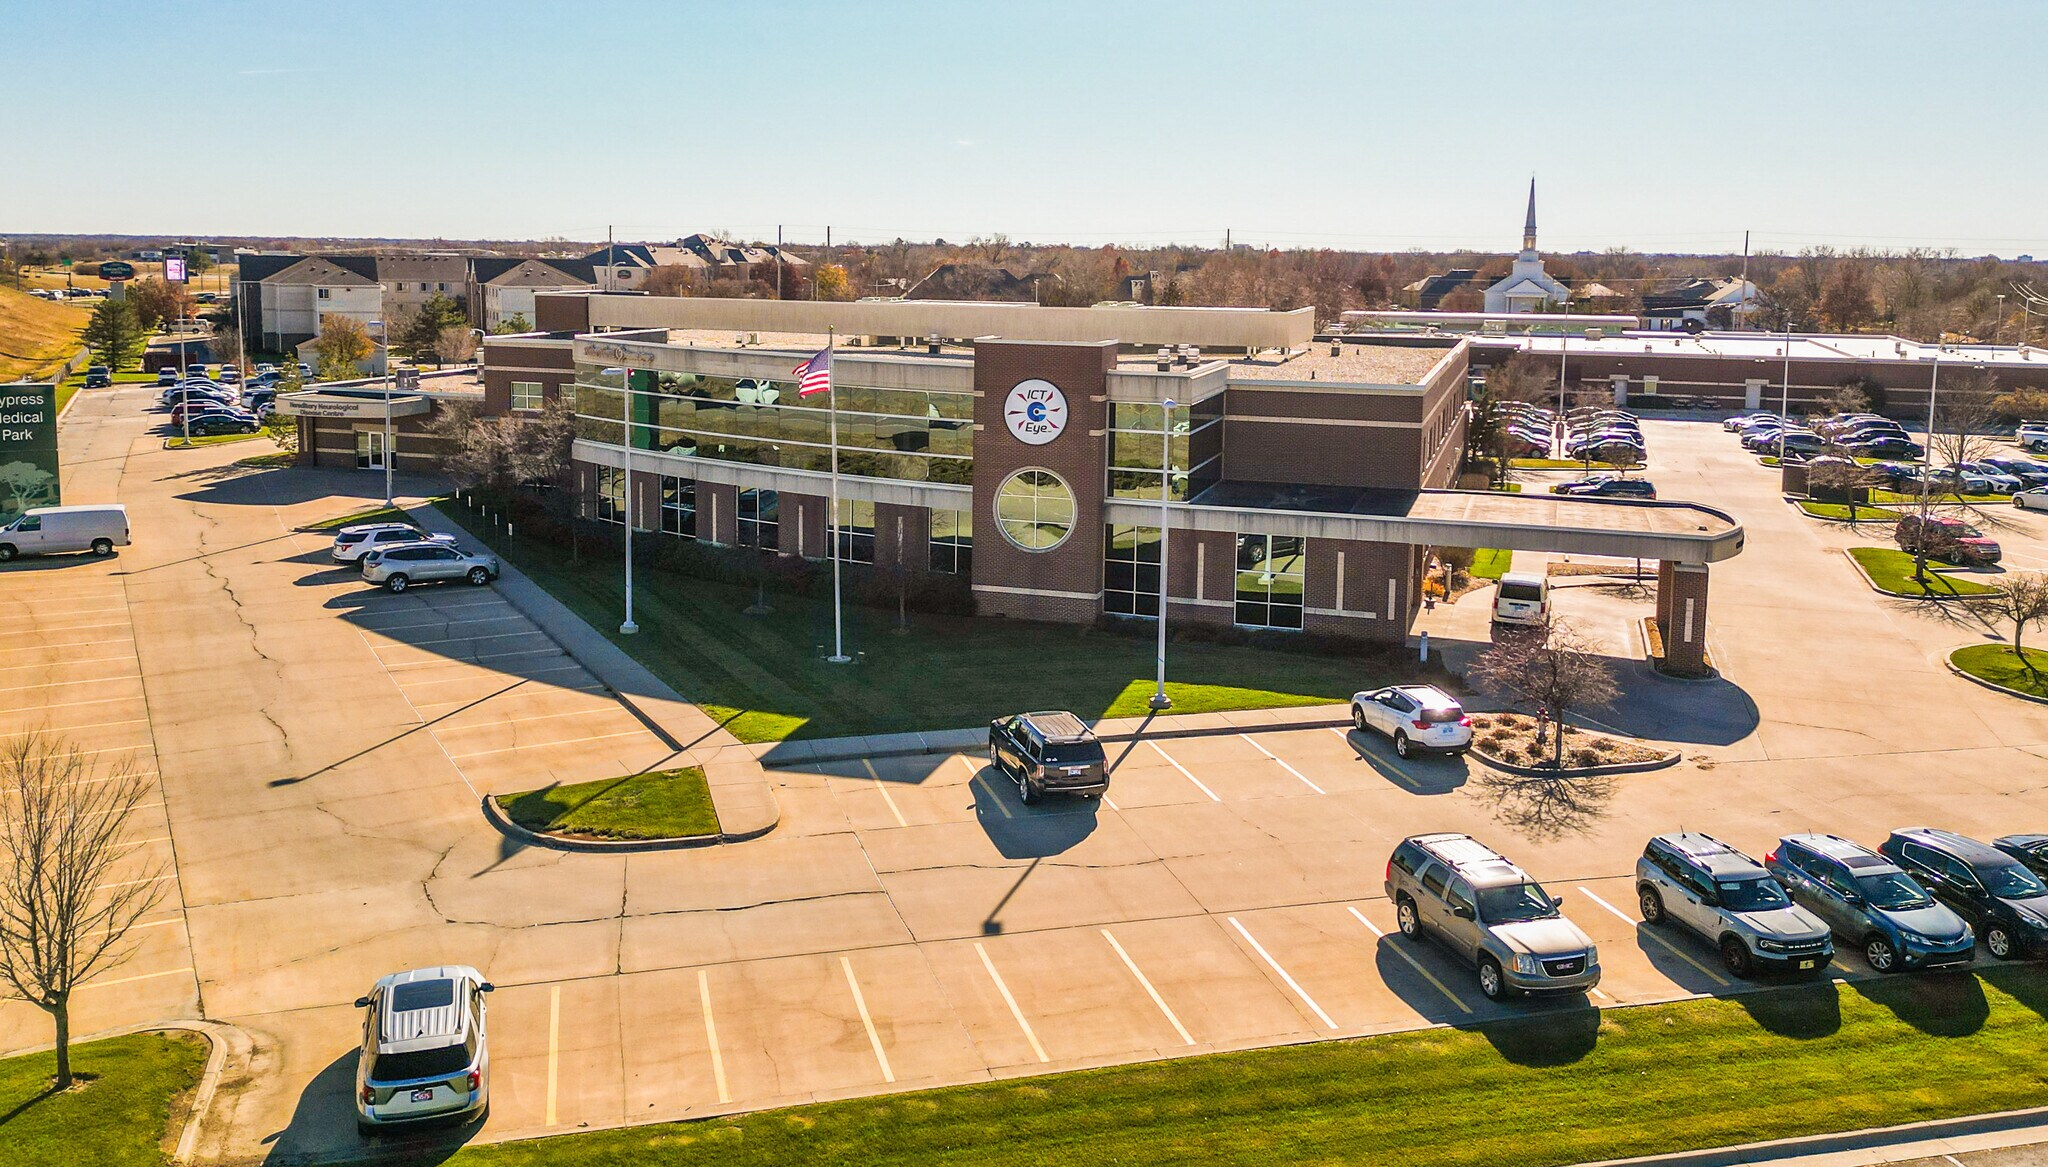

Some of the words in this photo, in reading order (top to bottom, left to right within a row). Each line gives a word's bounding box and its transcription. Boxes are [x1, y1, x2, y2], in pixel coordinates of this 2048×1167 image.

[1027, 389, 1047, 400] ICT
[0, 395, 44, 408] ypress
[318, 404, 359, 412] Neurological
[0, 411, 43, 424] edical
[1025, 422, 1047, 434] Eye
[2, 429, 33, 441] Park
